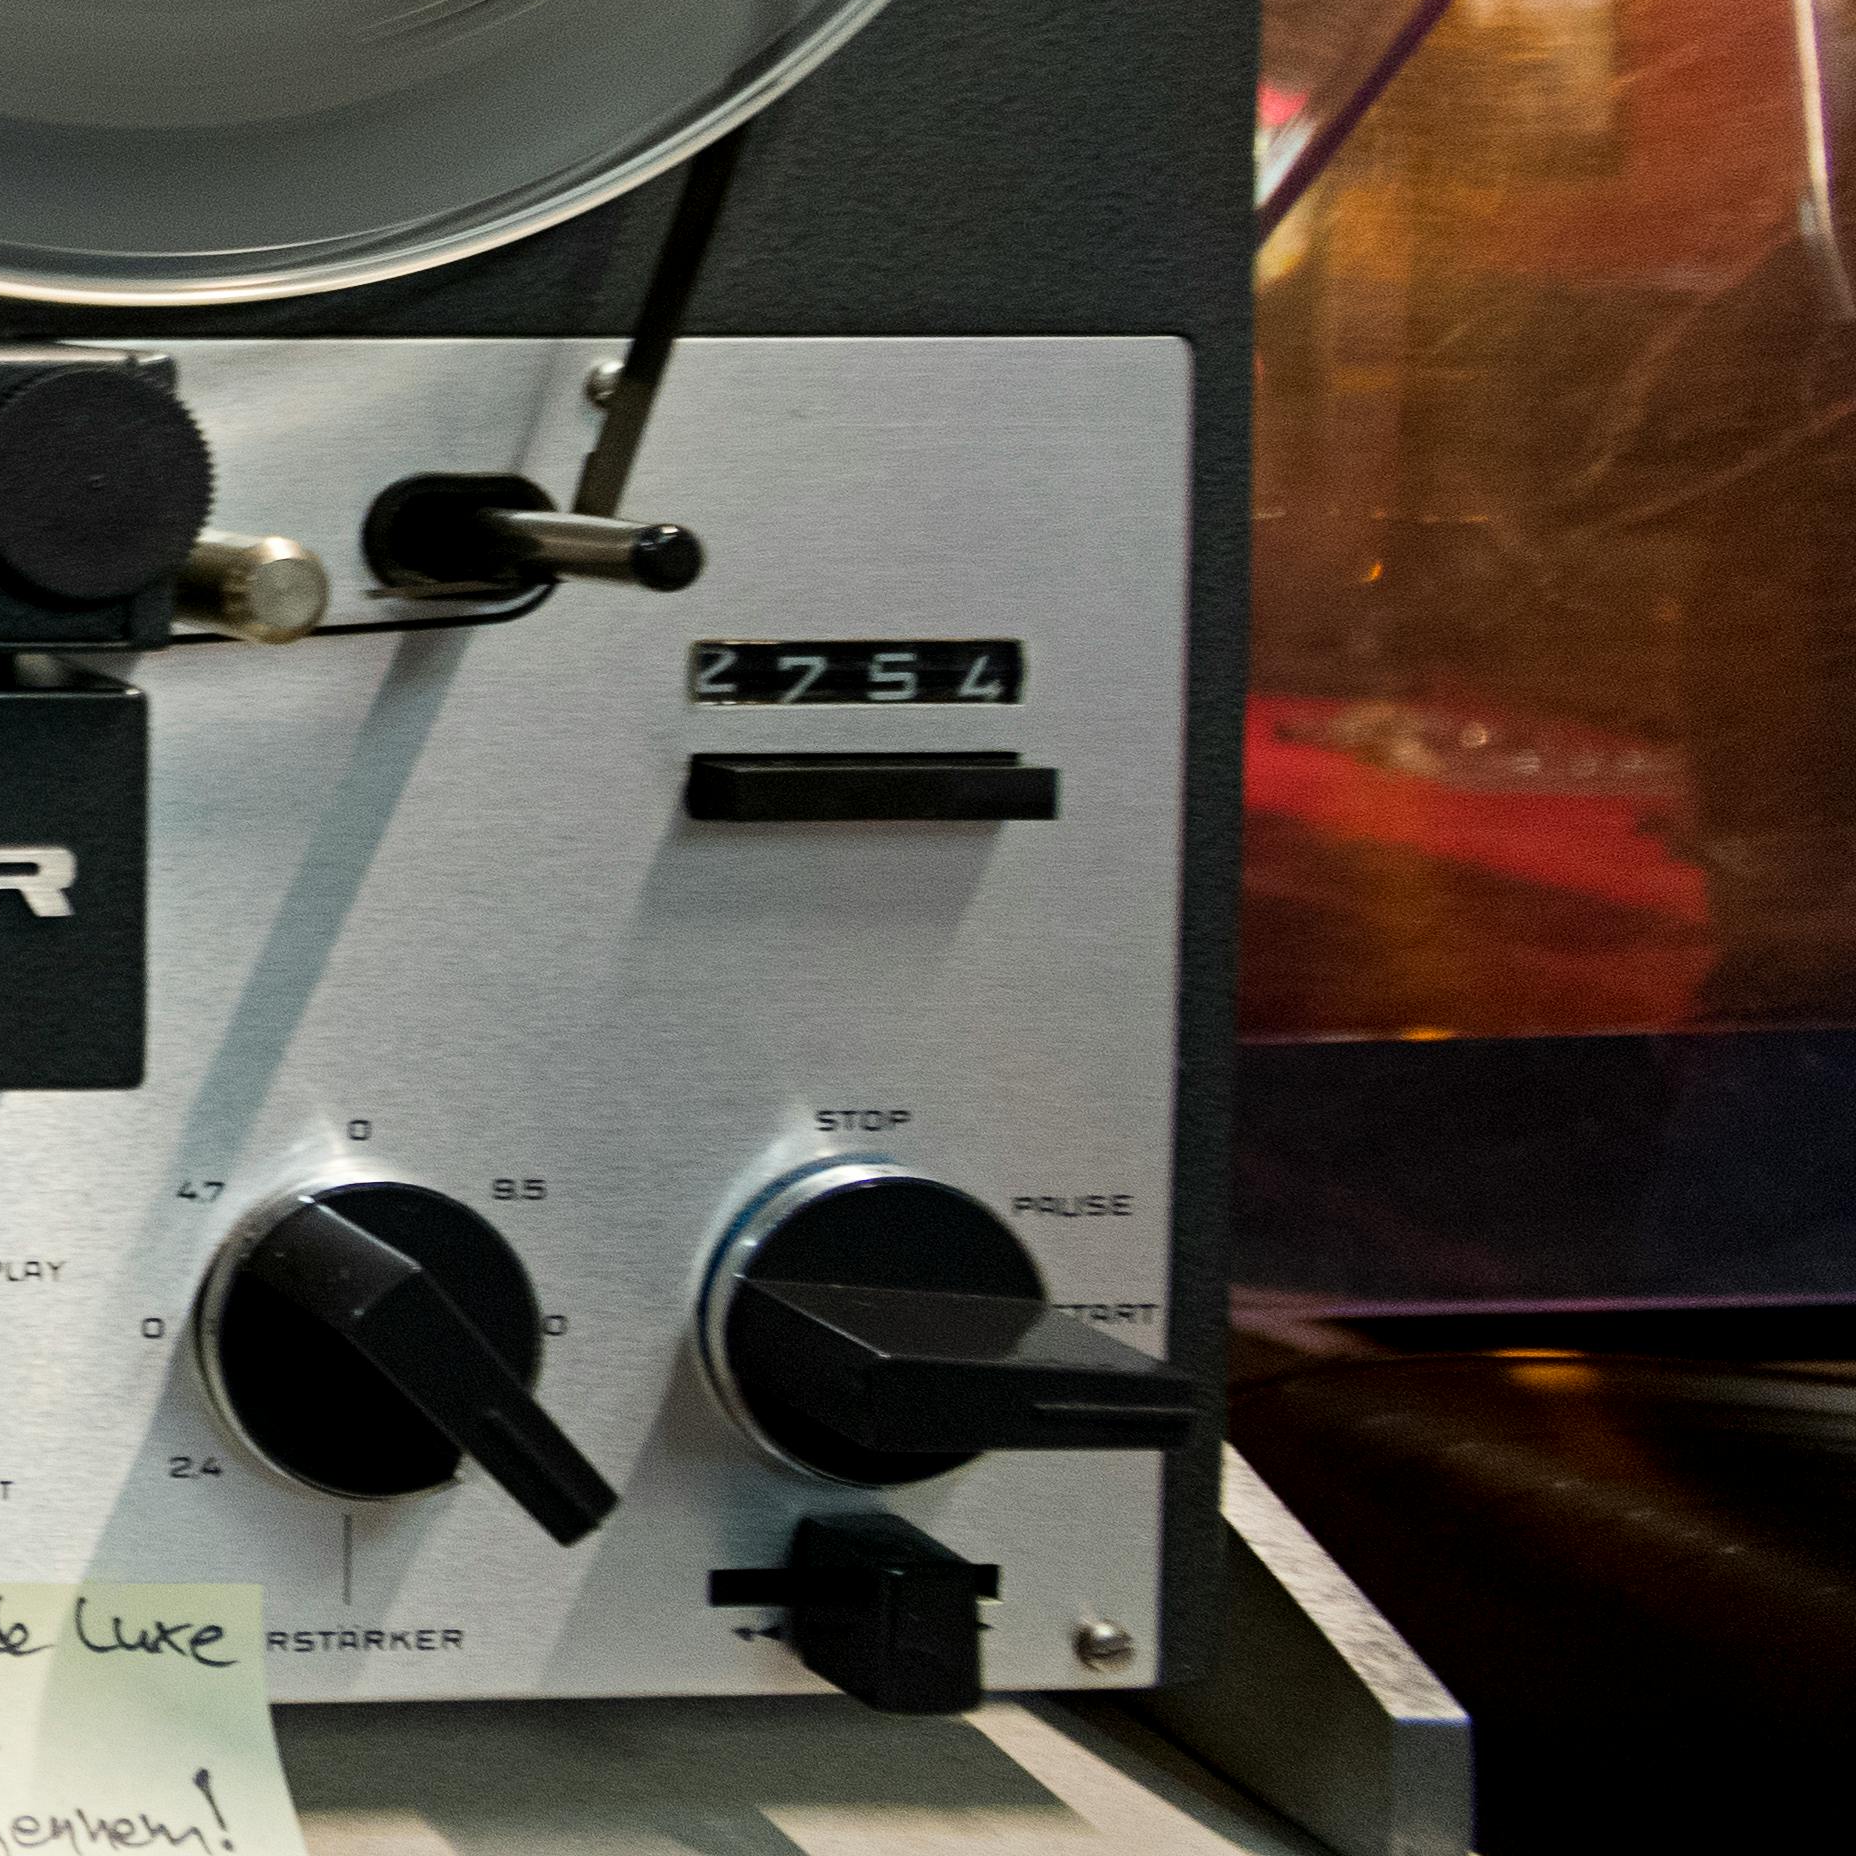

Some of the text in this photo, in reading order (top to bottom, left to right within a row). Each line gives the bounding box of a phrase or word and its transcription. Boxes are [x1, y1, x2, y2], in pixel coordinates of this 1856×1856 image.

[697, 648, 1005, 704] 2754
[817, 1109, 911, 1132] STOP
[1012, 1194, 1135, 1218] PAUSE
